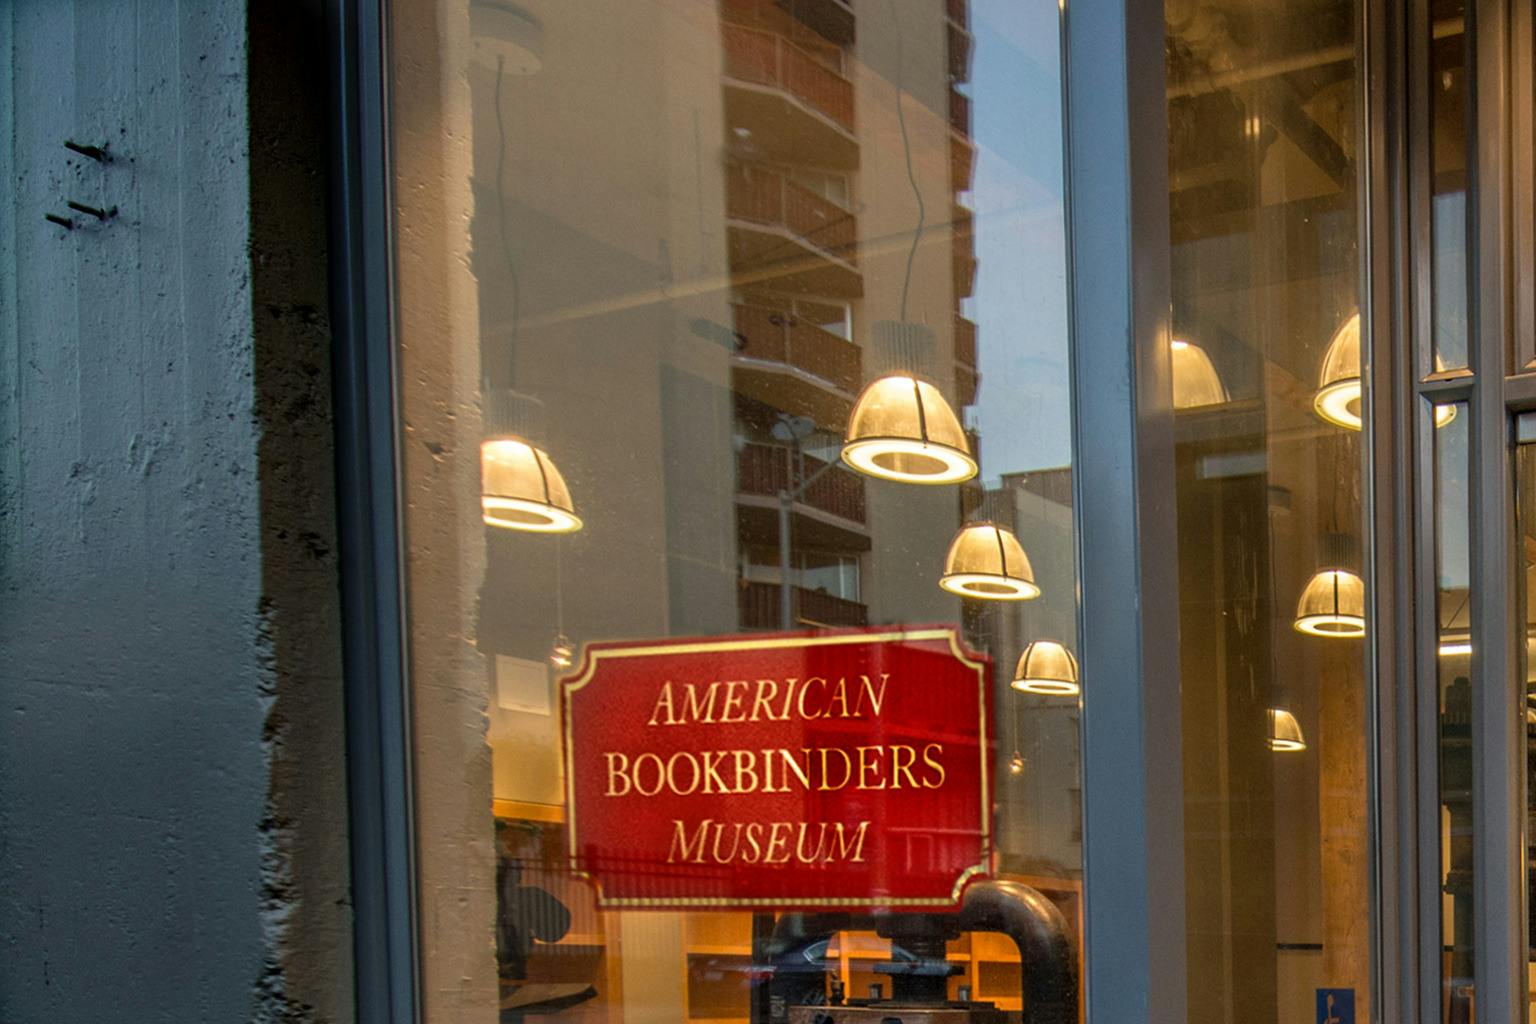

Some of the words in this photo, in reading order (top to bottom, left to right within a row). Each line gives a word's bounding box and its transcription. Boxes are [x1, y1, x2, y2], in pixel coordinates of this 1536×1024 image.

[647, 673, 890, 726] AMERICAN
[603, 743, 946, 797] BOOKBINDERS
[667, 820, 871, 864] MUSEUM
